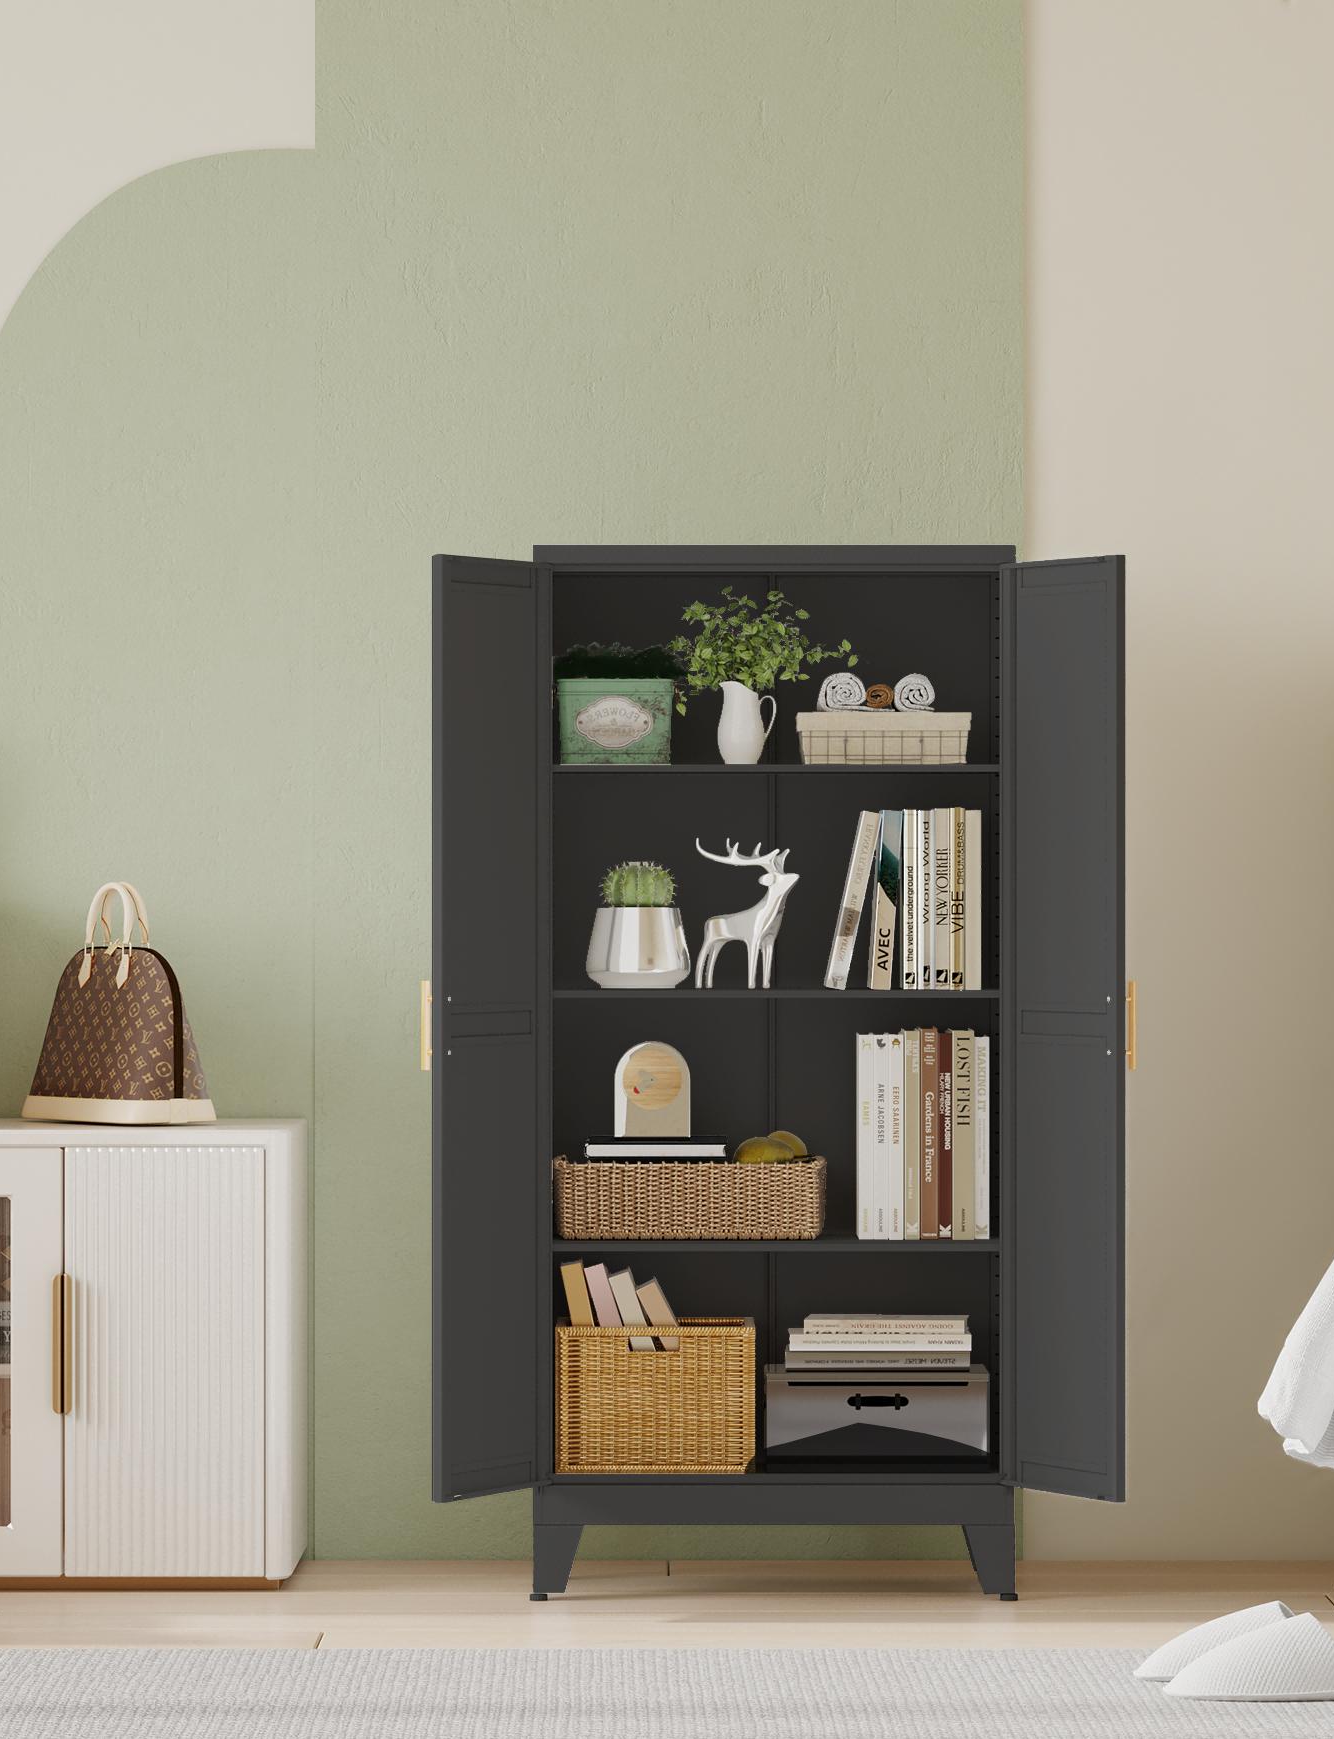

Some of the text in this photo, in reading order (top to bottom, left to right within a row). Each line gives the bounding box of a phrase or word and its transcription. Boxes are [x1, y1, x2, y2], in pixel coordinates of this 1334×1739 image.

[936, 848, 948, 926] NEW YORKER
[951, 822, 965, 934] VIBE DRUM&BASS
[906, 865, 915, 962] the velvet underground
[877, 928, 891, 971] AVEC
[956, 1037, 970, 1126] LOST FISH
[977, 1046, 986, 1096] MAKING
[877, 1083, 885, 1144] ARNE JACOBSEN
[892, 1086, 900, 1144] EERO SAARINEN
[924, 1091, 935, 1182] Gardens in France
[977, 1100, 986, 1113] IT
